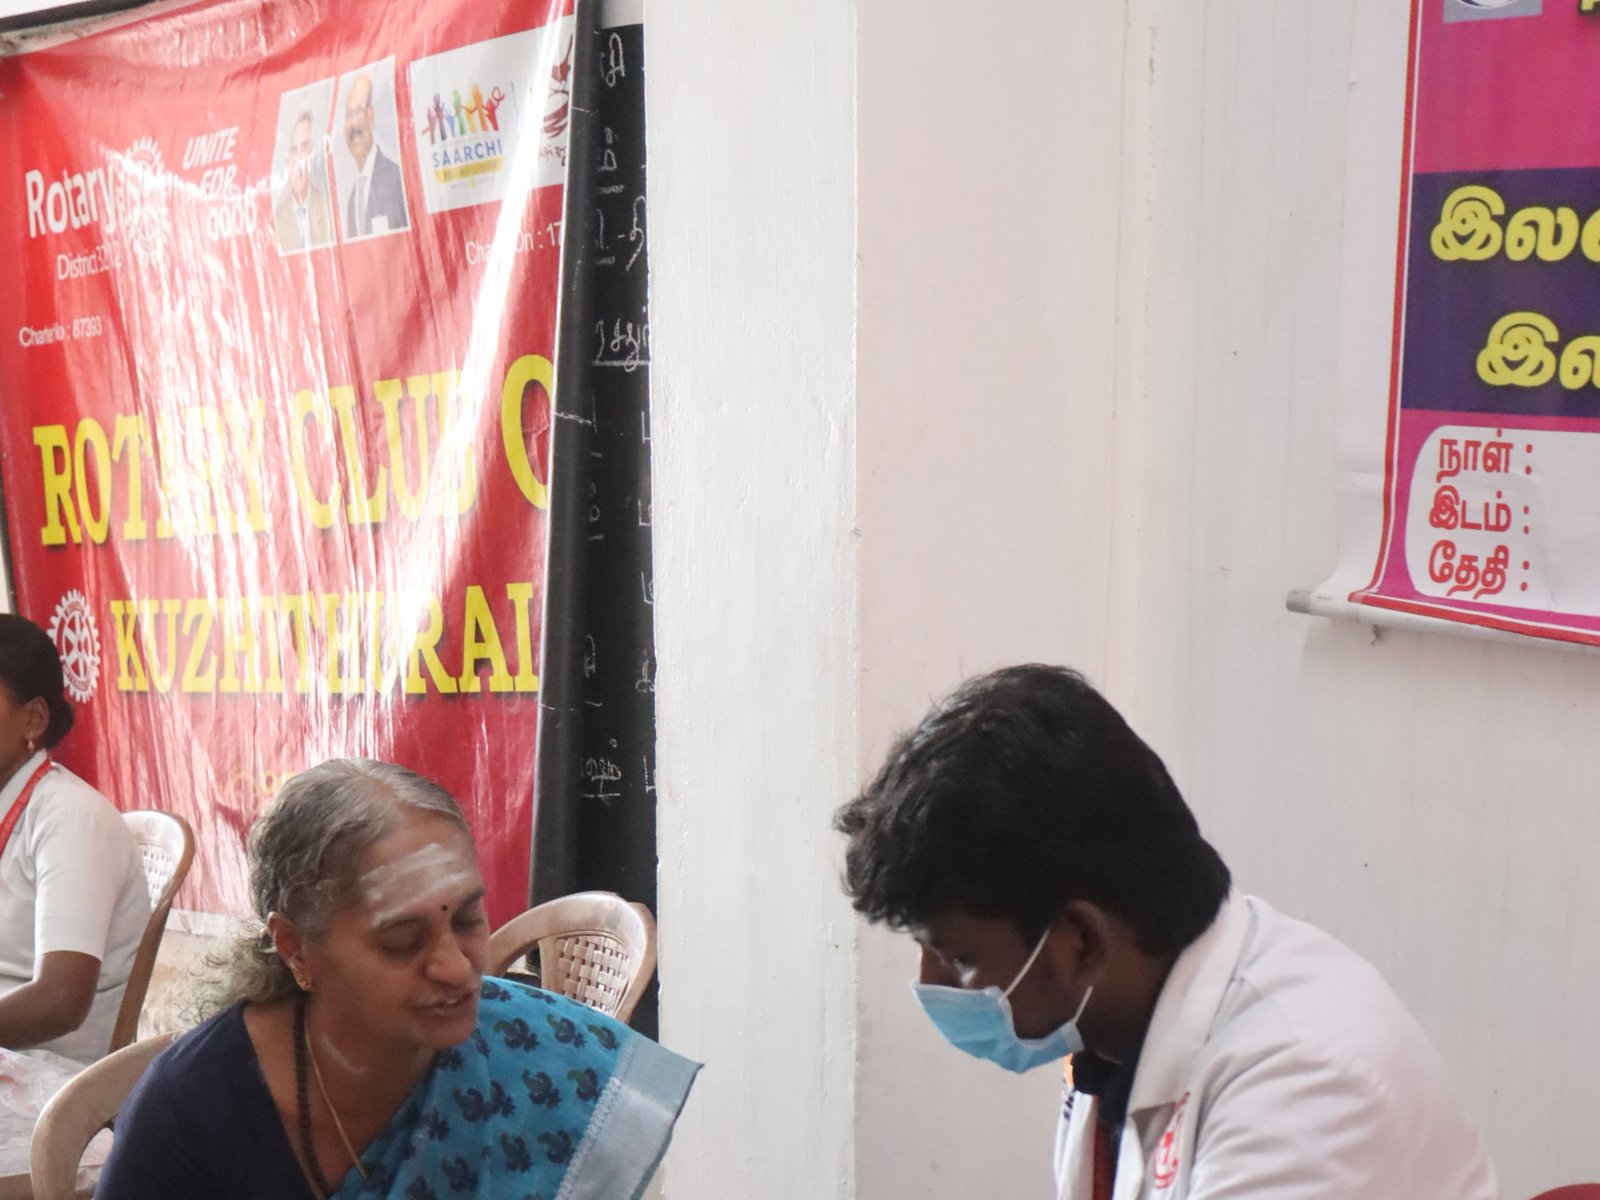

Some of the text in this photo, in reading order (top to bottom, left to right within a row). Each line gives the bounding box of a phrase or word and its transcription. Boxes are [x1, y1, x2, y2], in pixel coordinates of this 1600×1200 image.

[182, 125, 240, 170] UNITE
[432, 138, 502, 168] SAARCHI
[25, 163, 116, 239] Rotary
[201, 164, 238, 199] FOR
[1430, 185, 1600, 262] இல
[1436, 428, 1514, 483] நாள்
[1429, 485, 1512, 532] இடம்
[1428, 539, 1509, 600] தேதி
[110, 582, 539, 693] KUZHITHURAI
